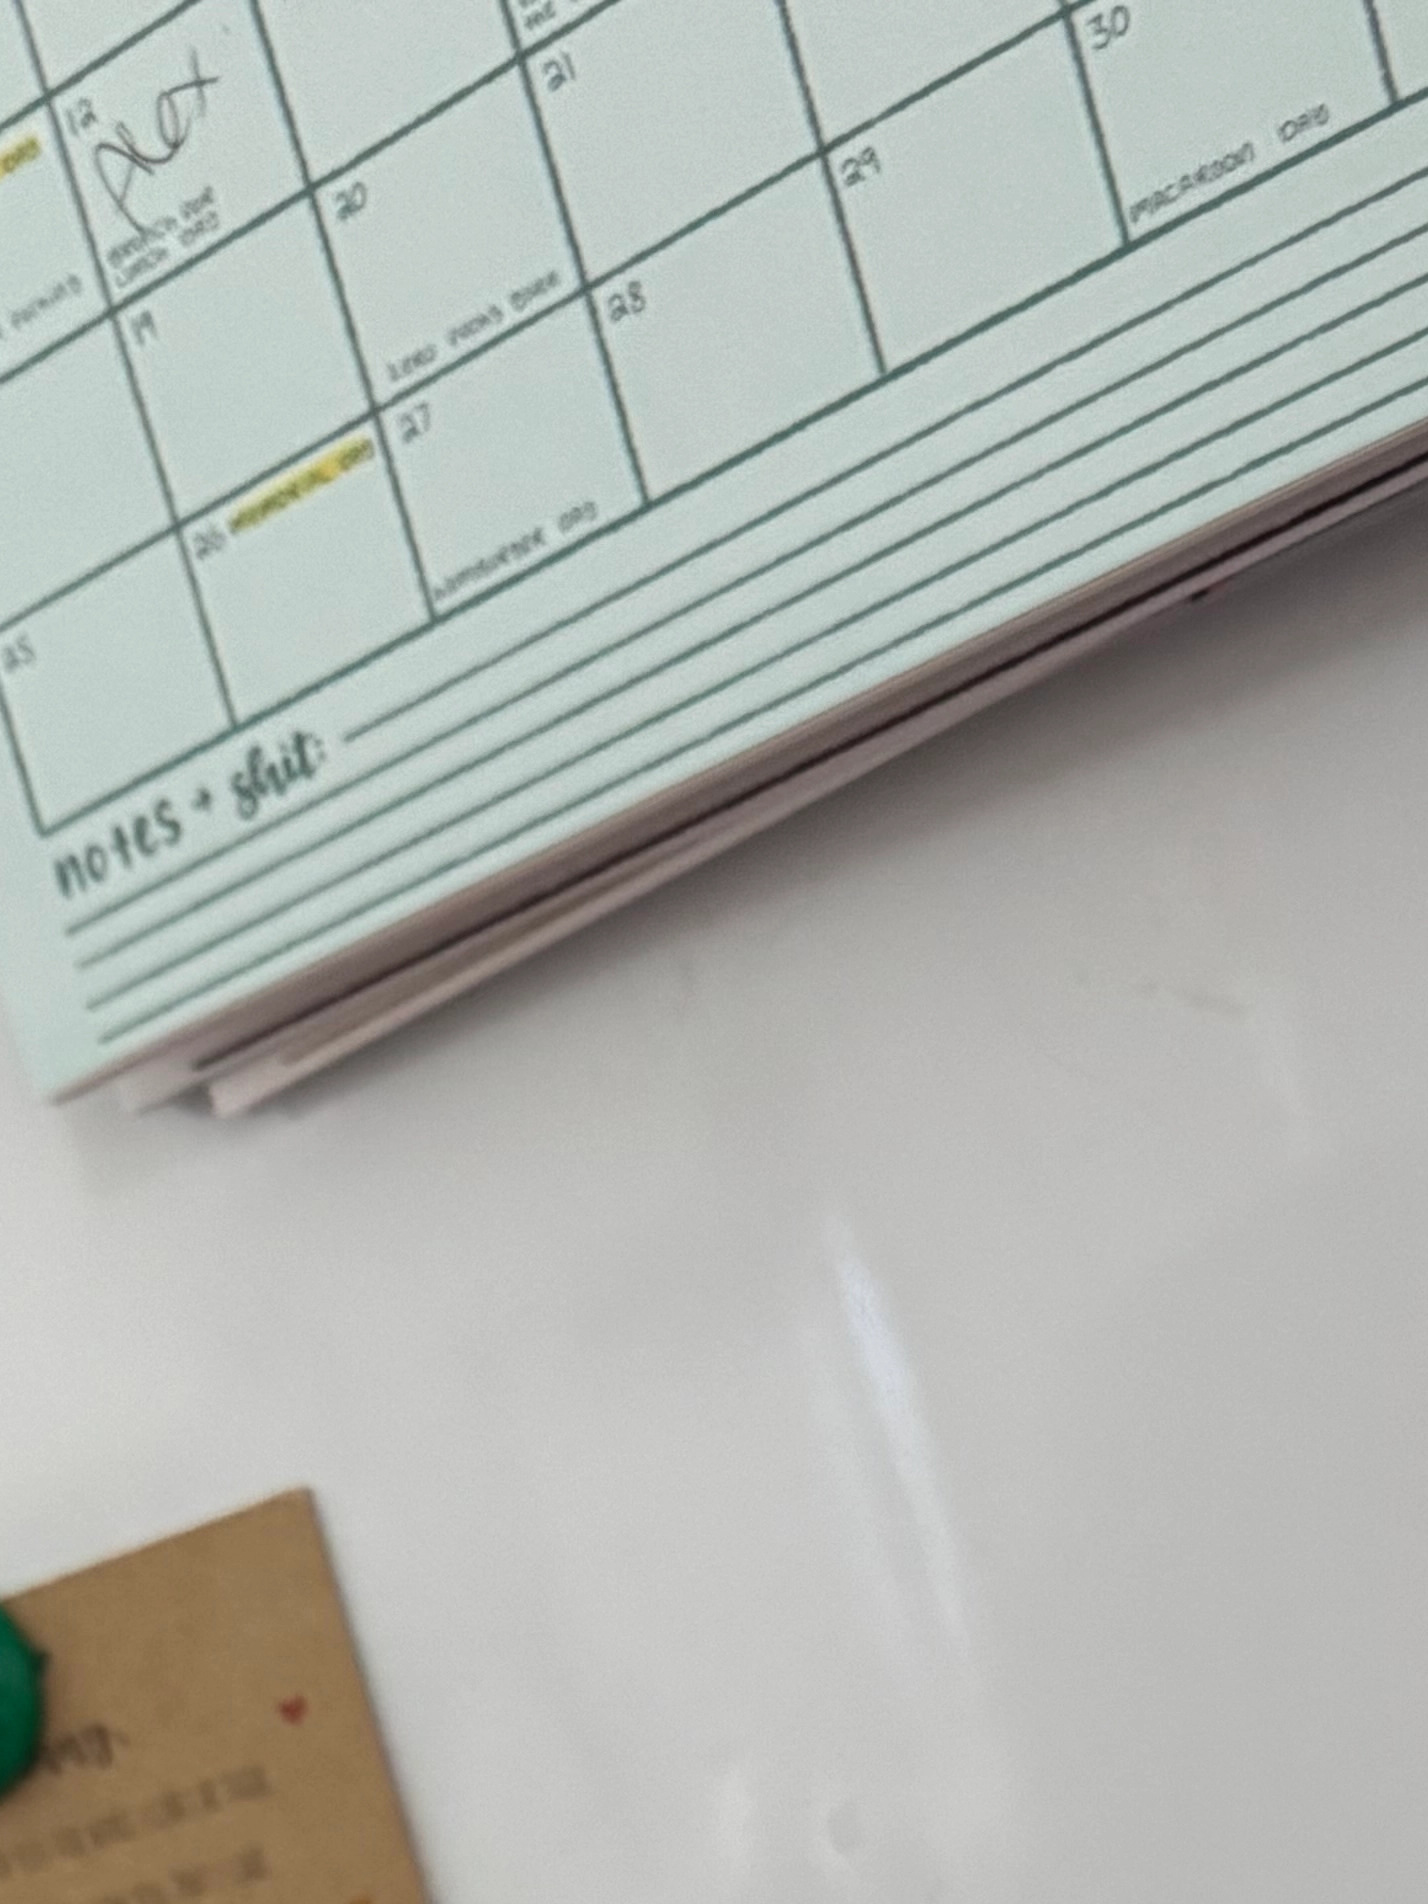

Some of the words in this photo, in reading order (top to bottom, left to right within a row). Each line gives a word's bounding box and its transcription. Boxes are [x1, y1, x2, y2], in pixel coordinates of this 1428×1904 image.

[334, 181, 369, 223] 20
[542, 50, 575, 92] 21
[1276, 103, 1330, 145] DAY
[1, 637, 37, 674] 25
[397, 404, 432, 445] 27
[608, 280, 647, 324] 28
[838, 146, 882, 189] 29
[1086, 5, 1131, 51] 30
[54, 799, 183, 899] notes
